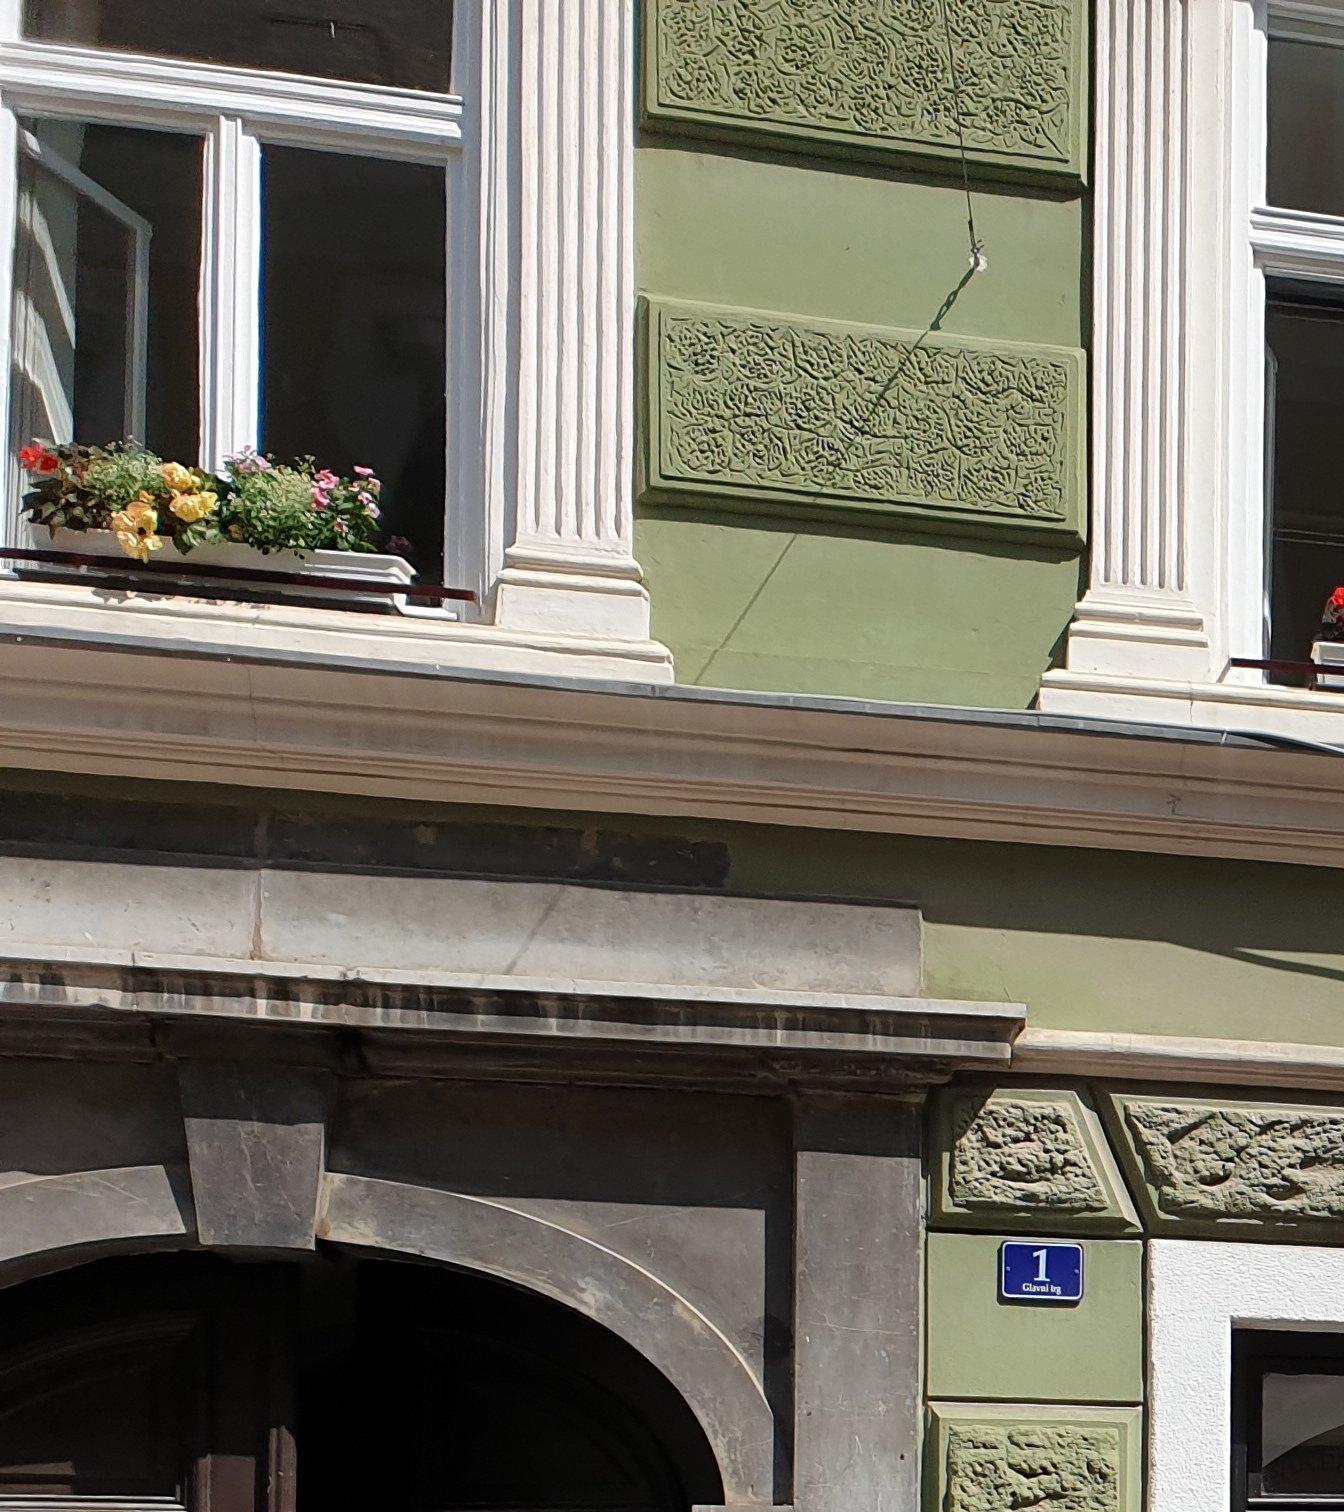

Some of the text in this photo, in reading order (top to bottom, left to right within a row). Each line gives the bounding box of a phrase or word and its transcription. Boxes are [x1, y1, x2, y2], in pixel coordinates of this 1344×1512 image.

[1032, 1248, 1051, 1281] 1
[1022, 1283, 1061, 1295] Glavni trg
